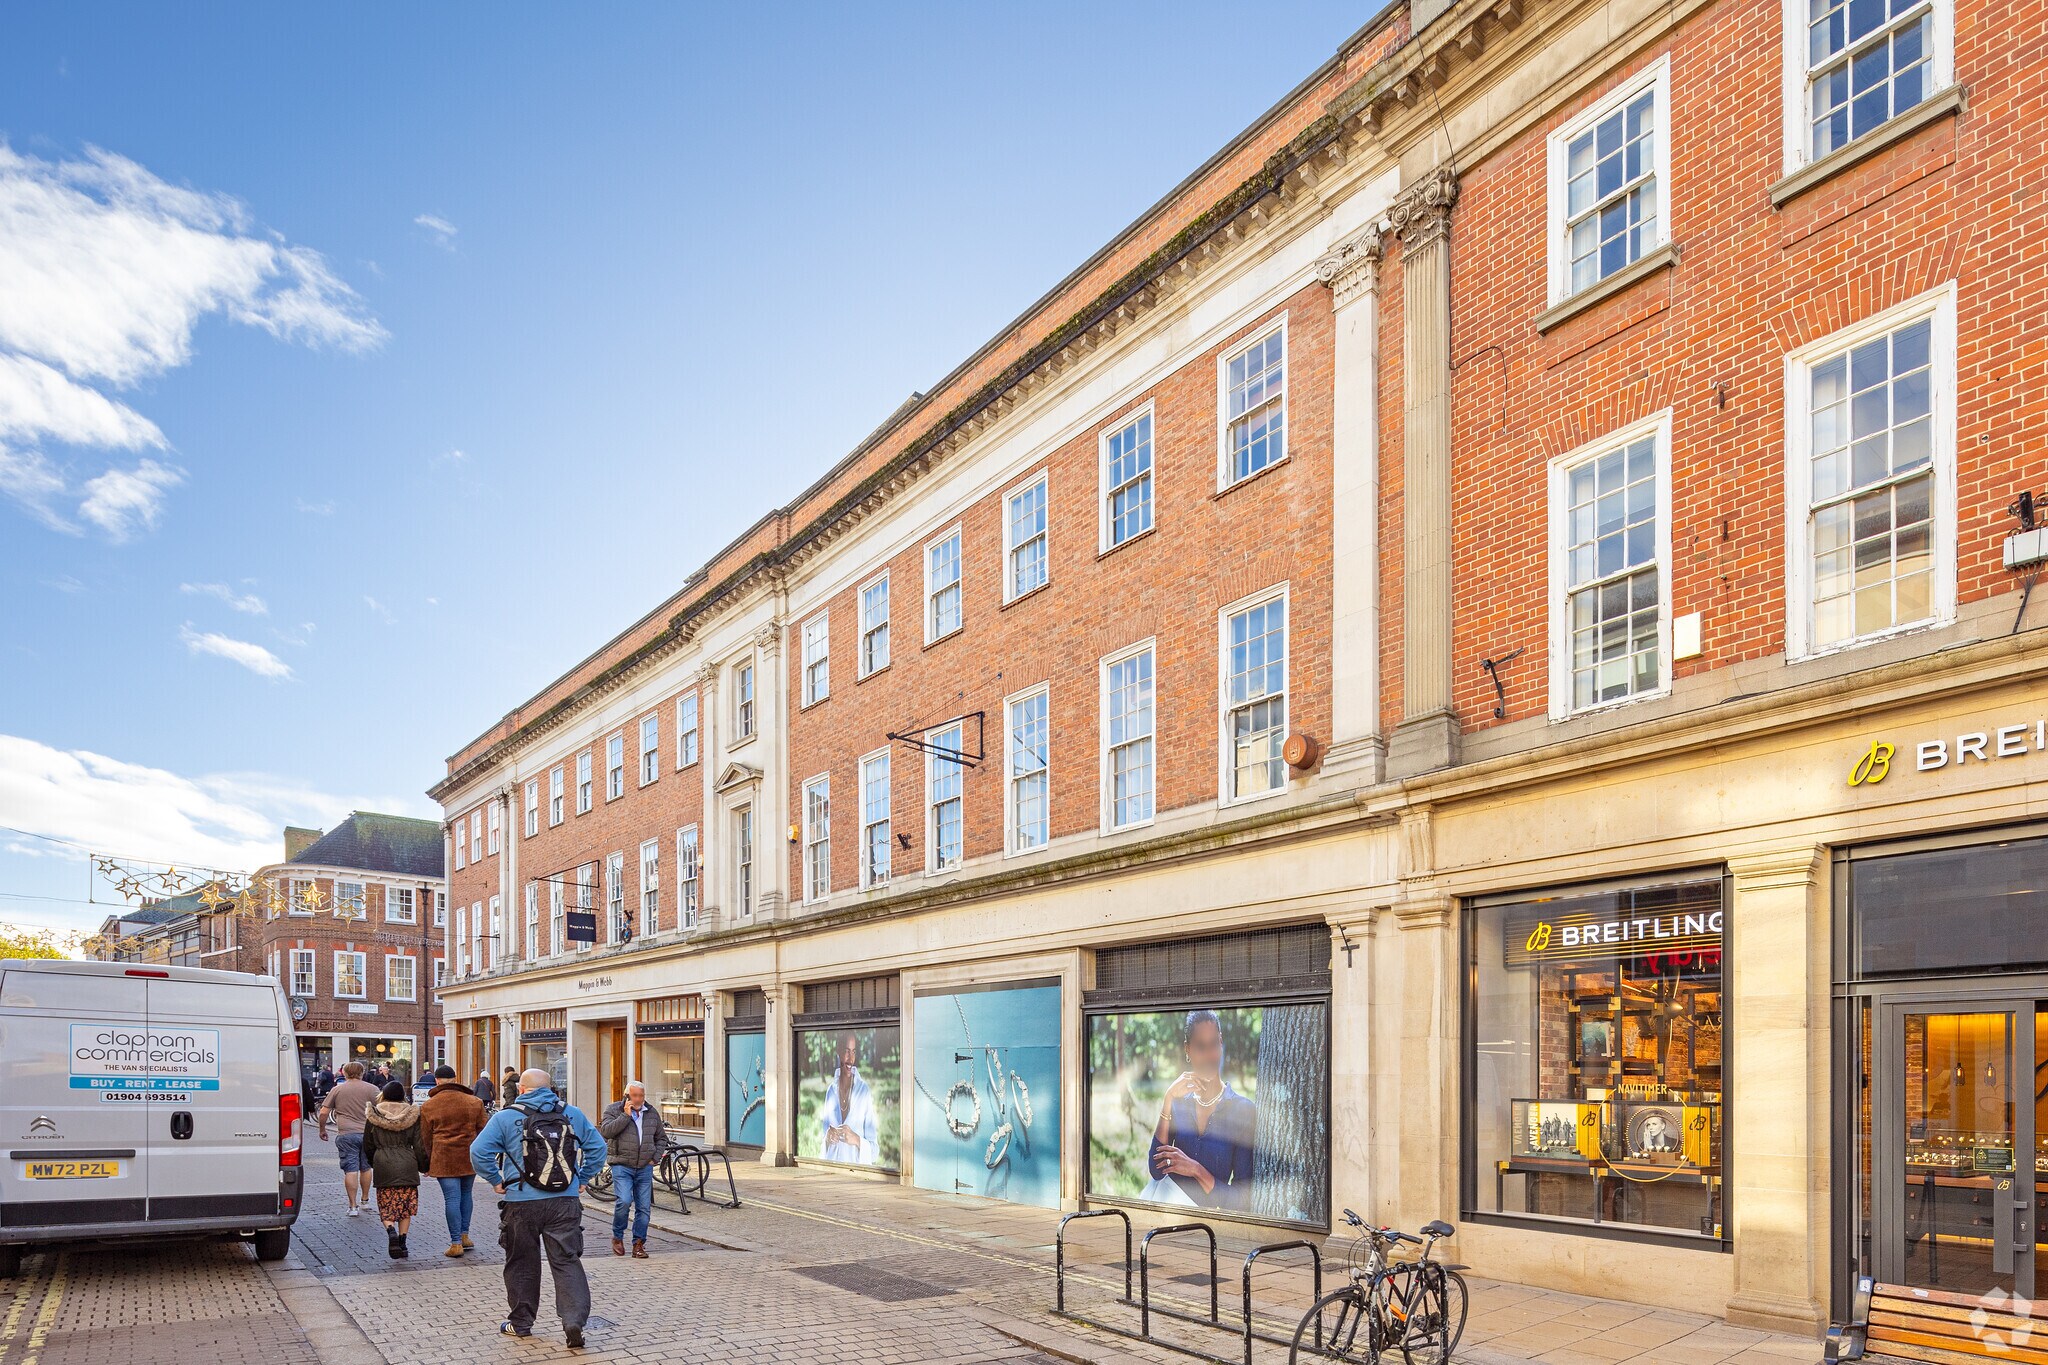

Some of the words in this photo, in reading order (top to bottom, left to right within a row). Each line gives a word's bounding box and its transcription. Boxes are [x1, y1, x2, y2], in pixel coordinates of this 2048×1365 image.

[1916, 719, 2045, 772] BREI
[578, 979, 595, 992] Mappin
[600, 976, 612, 987] Webb
[306, 1020, 356, 1030] NERO
[96, 1030, 195, 1051] clapham
[75, 1048, 215, 1064] commercials
[90, 1079, 115, 1087] BUY
[125, 1080, 156, 1088] RENT
[165, 1081, 201, 1089] LEASE
[1617, 1083, 1667, 1095] NAVITIMER
[106, 1093, 142, 1101] 01904
[145, 1093, 186, 1101] 693514
[1529, 1103, 1539, 1146] AVENGER
[32, 1164, 75, 1176] MW72
[80, 1163, 110, 1175] PZL
